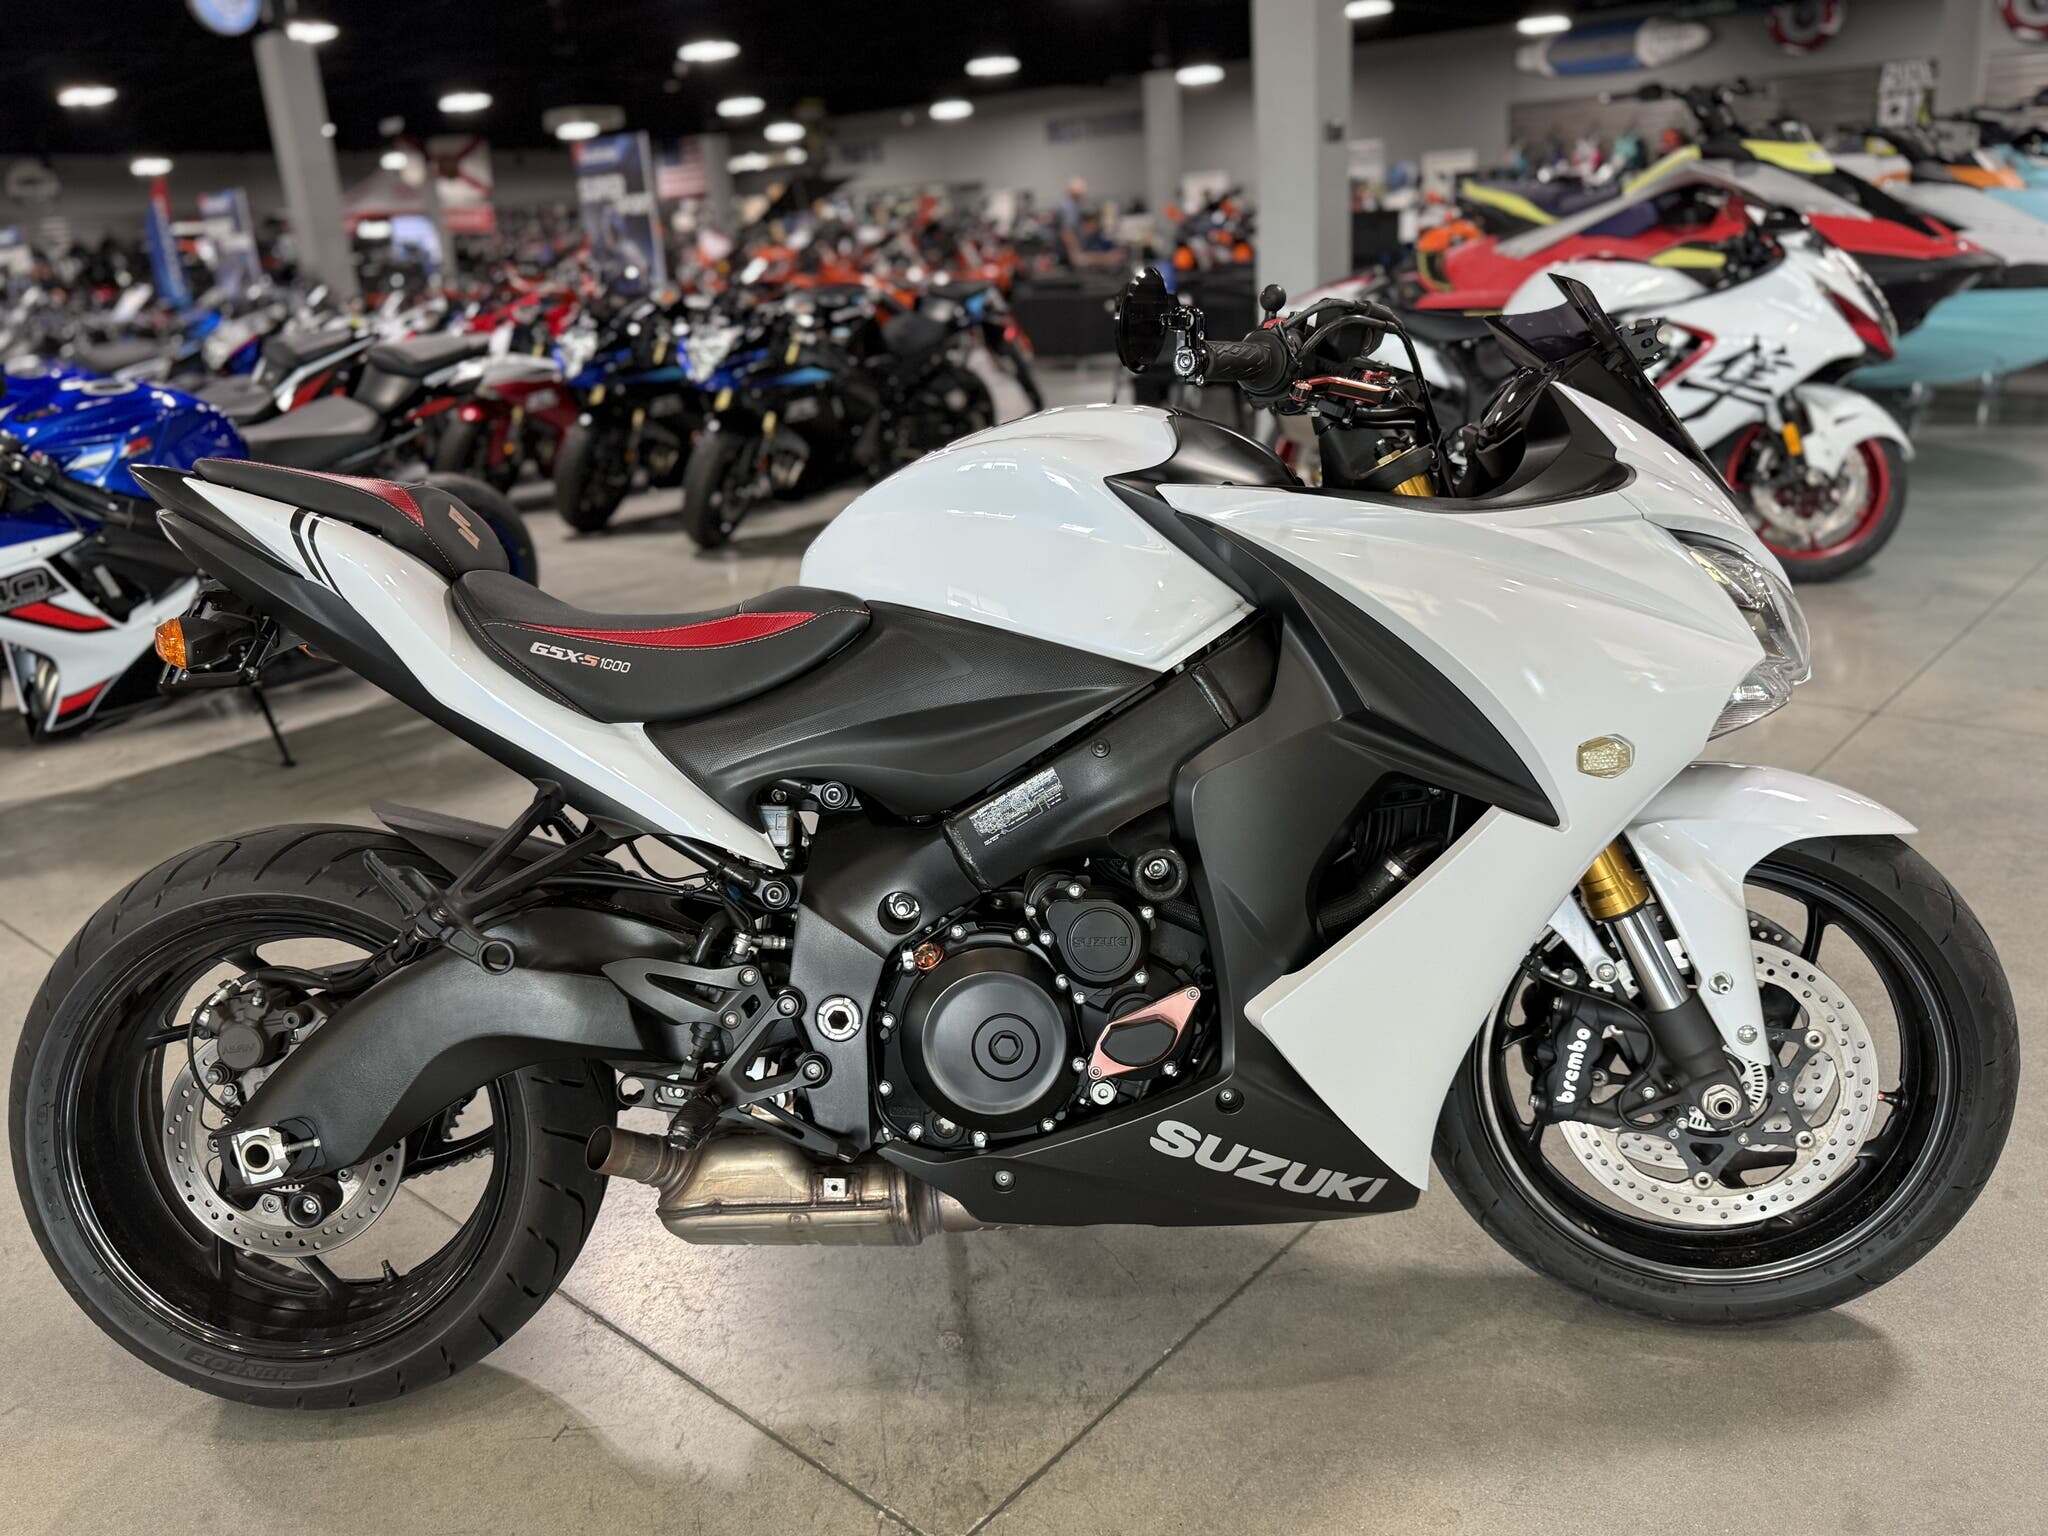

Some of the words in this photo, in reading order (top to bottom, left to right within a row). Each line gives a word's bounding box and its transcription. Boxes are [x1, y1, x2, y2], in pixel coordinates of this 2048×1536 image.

[1072, 936, 1129, 948] SUZUKI
[1555, 1027, 1592, 1104] brembo
[1149, 1119, 1390, 1203] SUZUKI
